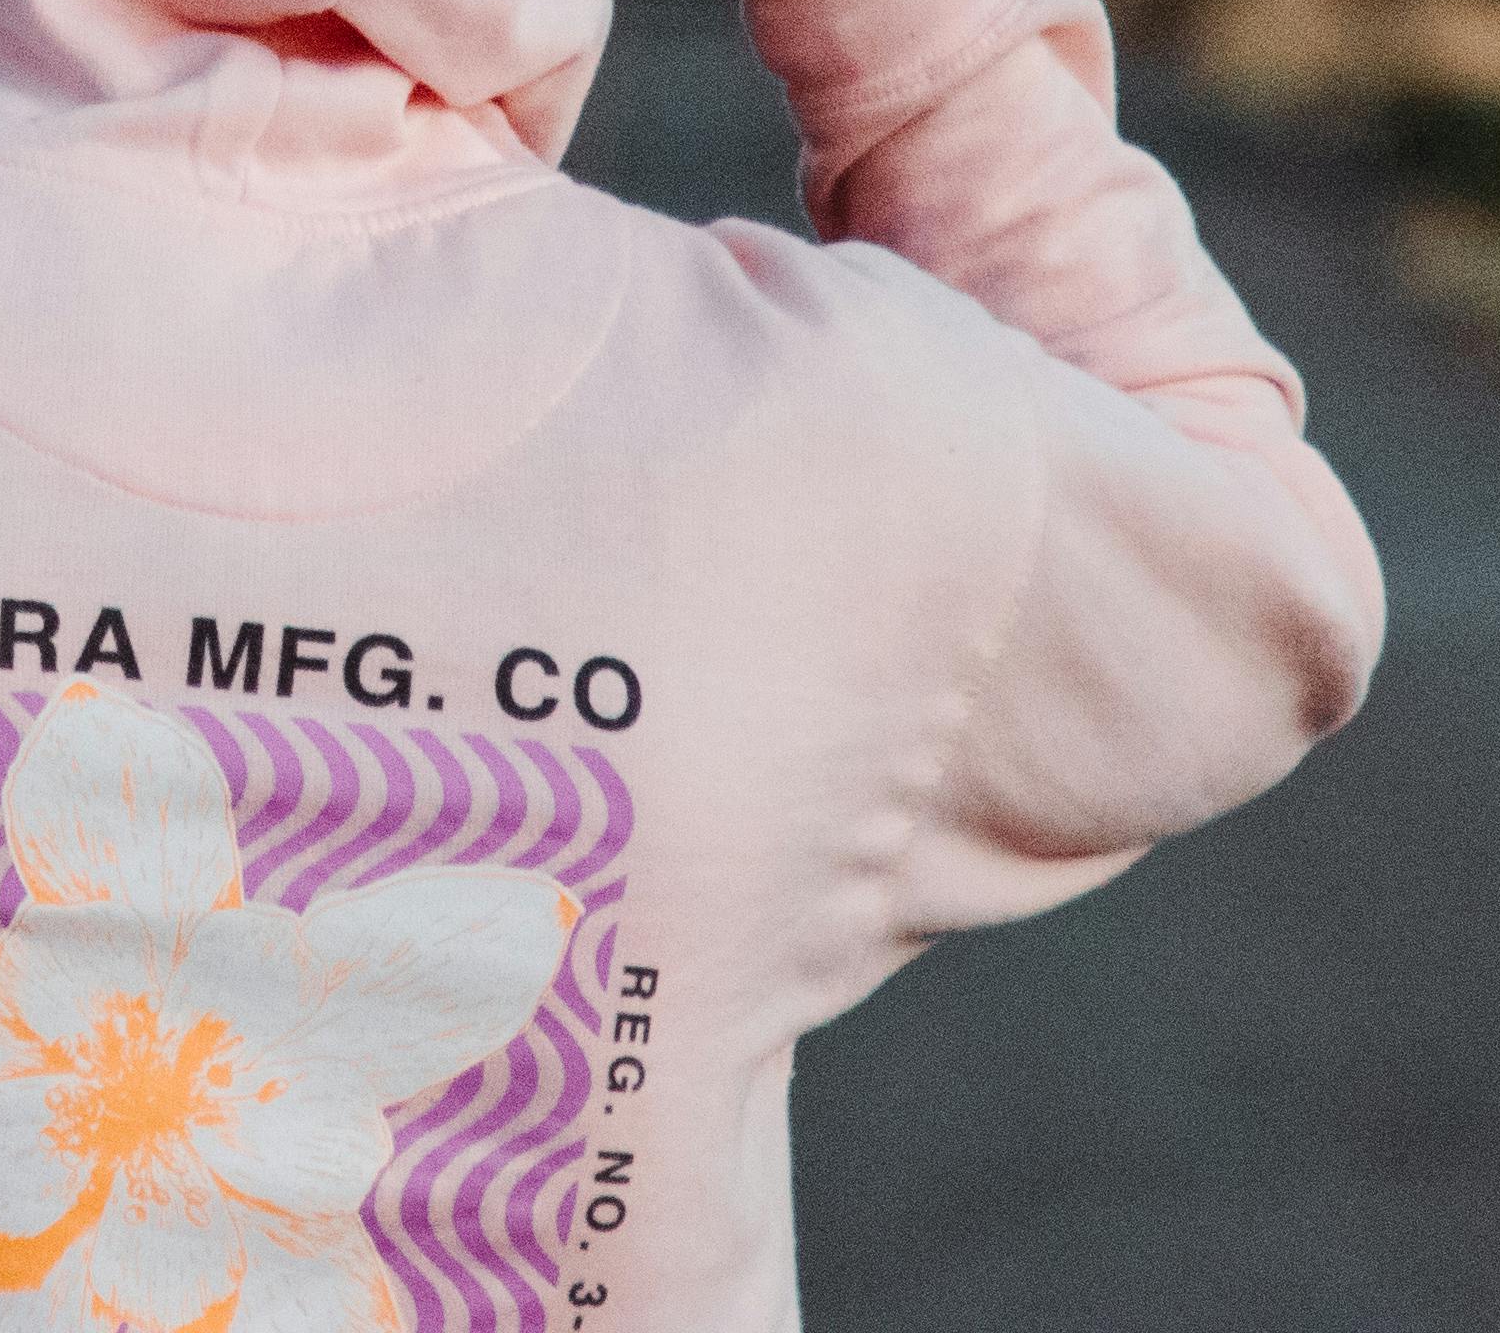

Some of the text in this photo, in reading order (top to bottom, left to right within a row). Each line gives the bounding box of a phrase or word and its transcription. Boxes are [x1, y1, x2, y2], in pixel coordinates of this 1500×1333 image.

[185, 616, 446, 712] MFG.
[493, 647, 643, 732] CO
[606, 965, 659, 1115] REG.
[579, 1150, 635, 1250] NO.
